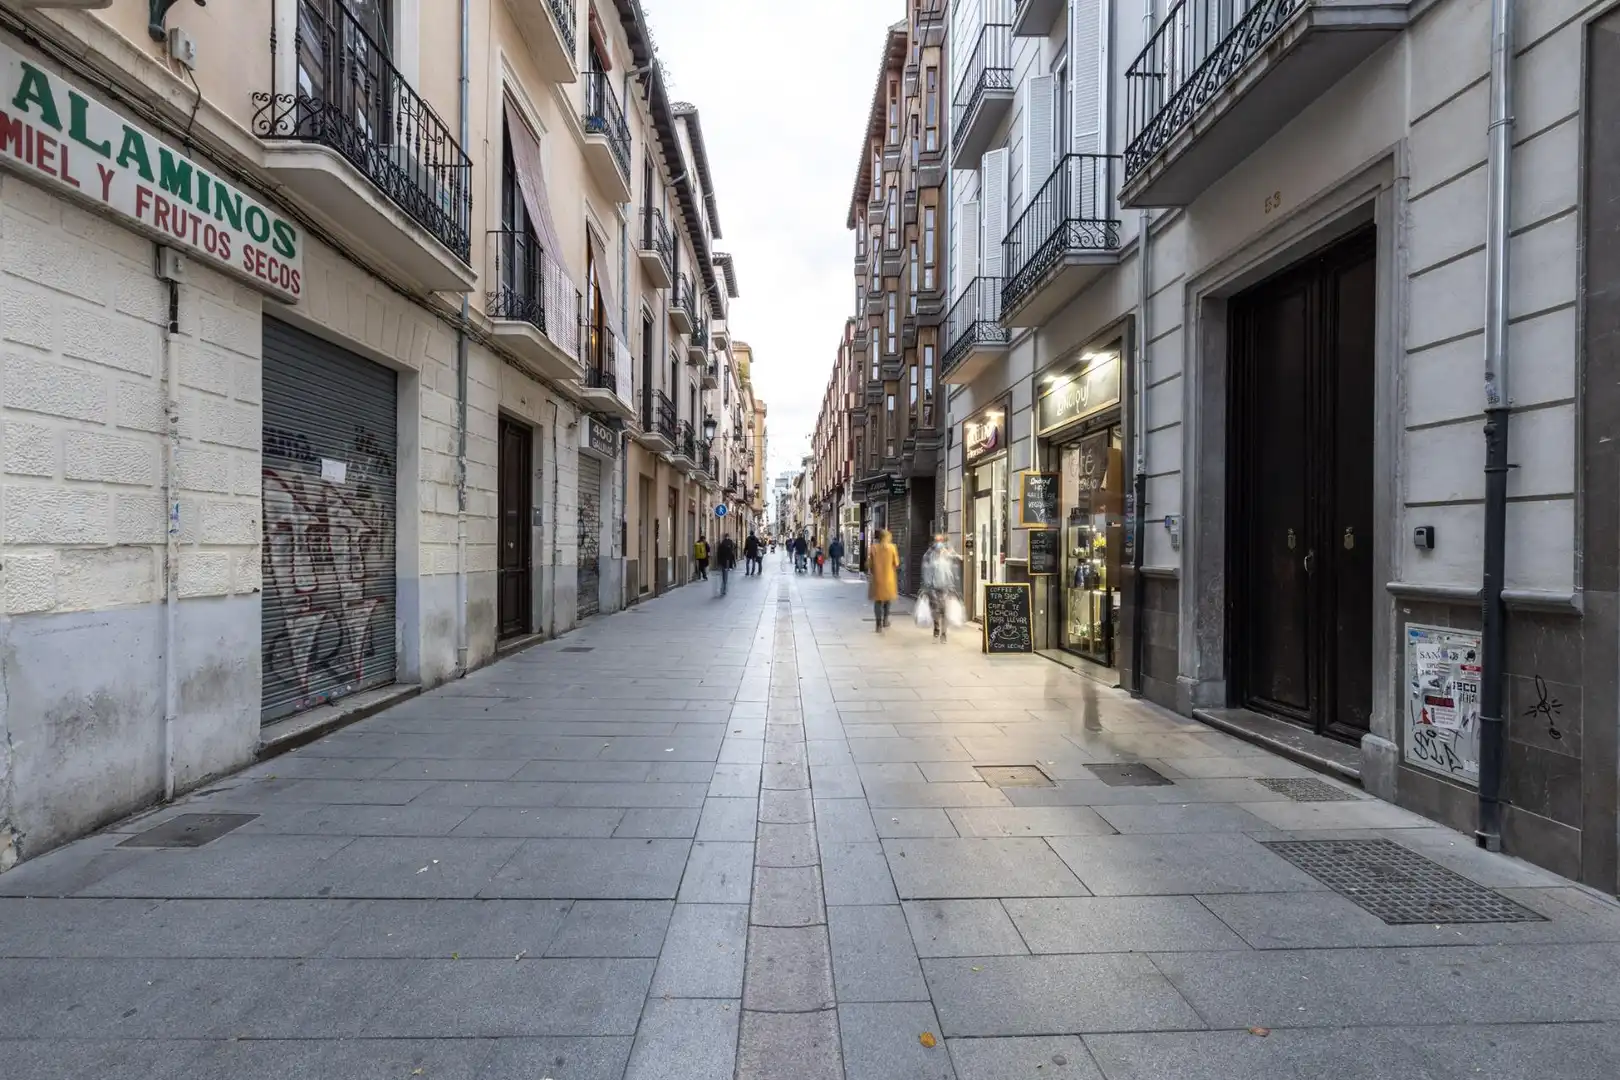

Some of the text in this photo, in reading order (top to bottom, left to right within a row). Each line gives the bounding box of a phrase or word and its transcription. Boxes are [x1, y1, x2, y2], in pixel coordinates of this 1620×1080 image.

[0, 111, 301, 295] MIEL Y FRUTOS SECOS
[12, 61, 296, 259] ALAMINOS
[593, 424, 612, 443] 400
[990, 592, 1003, 600] TEA
